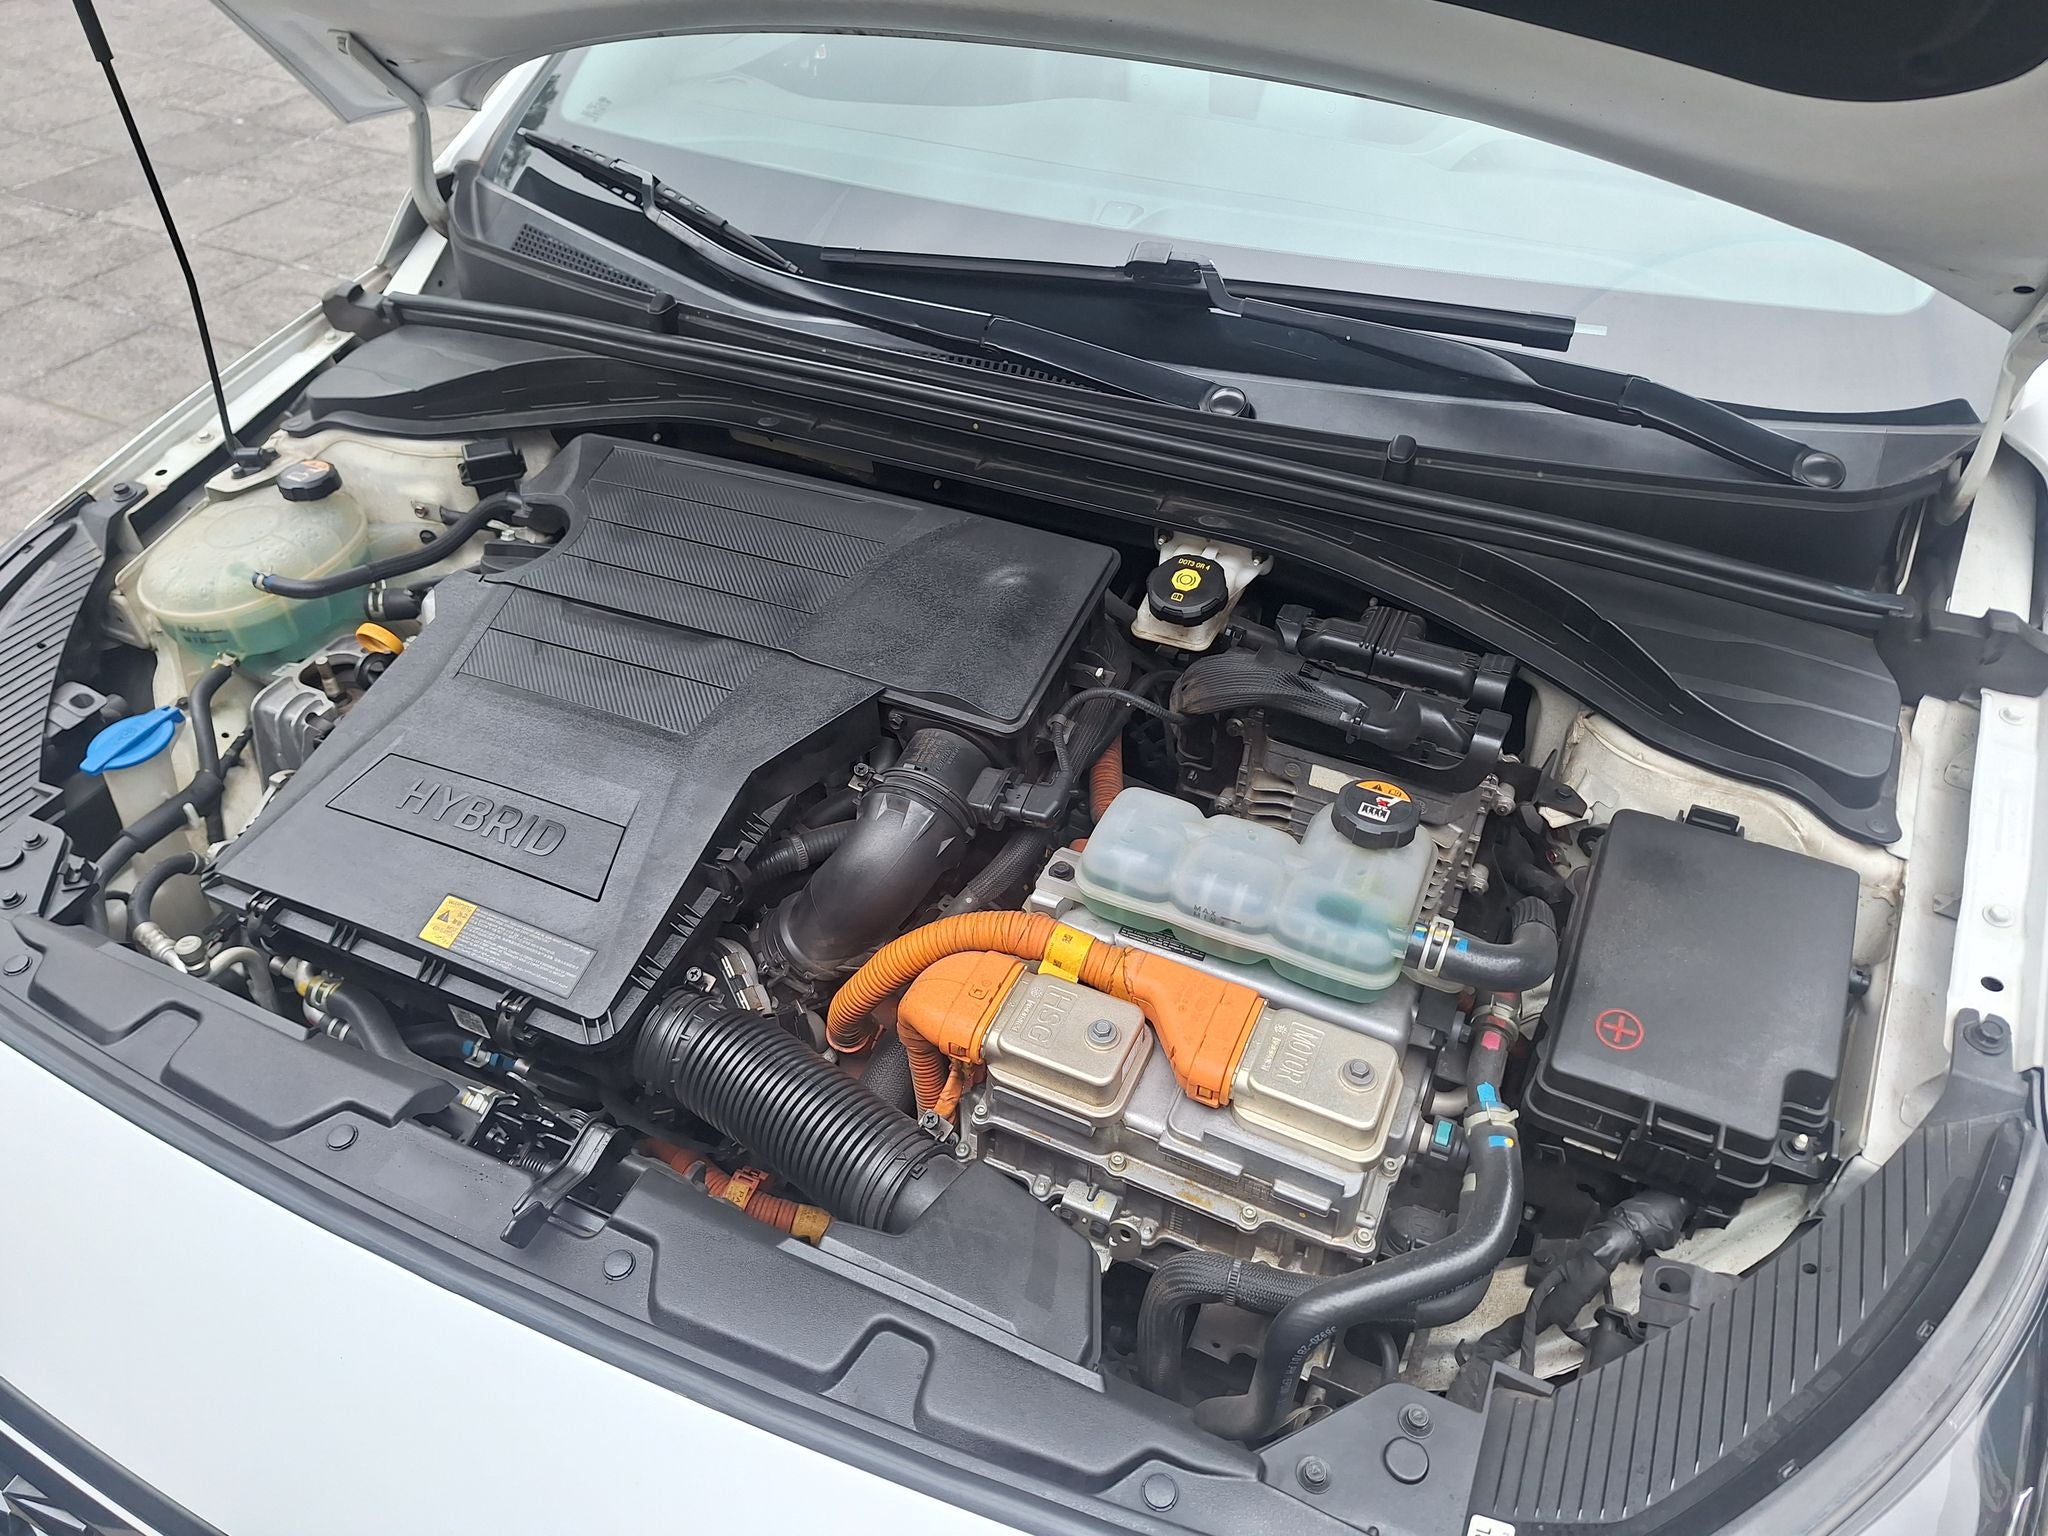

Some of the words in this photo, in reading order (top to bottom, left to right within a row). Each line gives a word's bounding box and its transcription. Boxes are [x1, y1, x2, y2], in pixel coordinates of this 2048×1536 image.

[1178, 558, 1195, 567] DOT3
[1195, 562, 1206, 570] OR
[396, 778, 567, 856] HYBRID
[1193, 904, 1216, 916] MAX
[1027, 991, 1075, 1044] HSG
[1276, 1027, 1320, 1086] MOTOR
